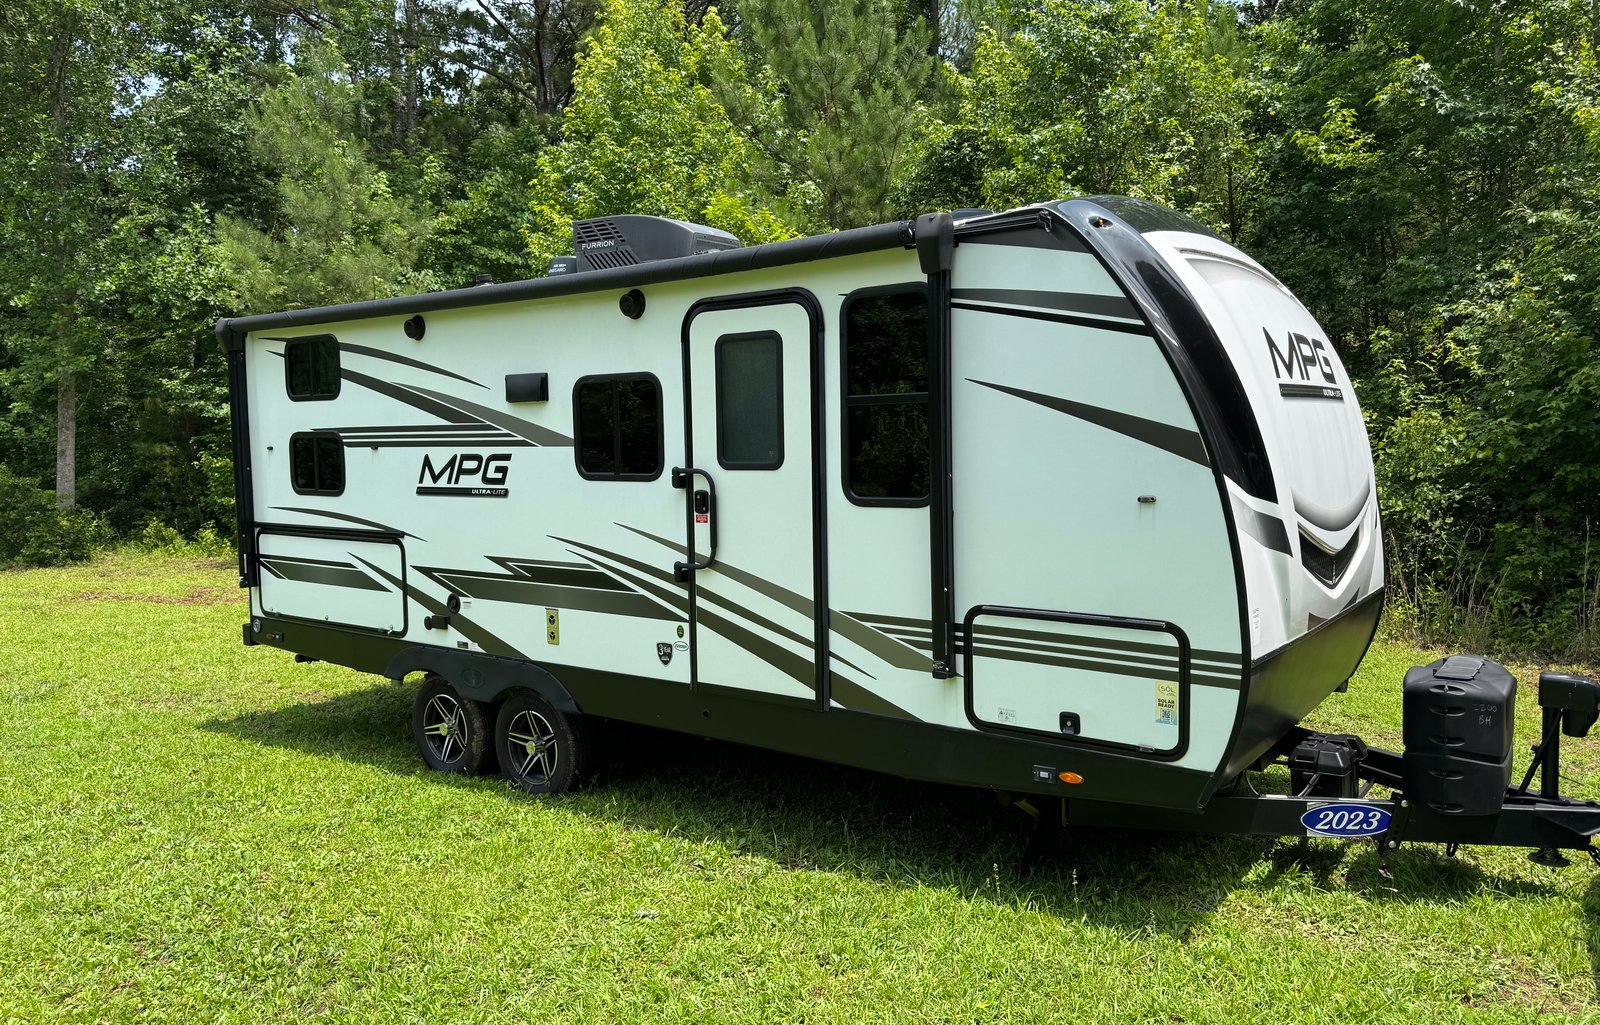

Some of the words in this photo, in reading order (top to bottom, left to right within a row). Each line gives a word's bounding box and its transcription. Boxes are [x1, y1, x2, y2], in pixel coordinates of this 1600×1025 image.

[581, 239, 615, 250] FURRION
[1262, 326, 1337, 385] MPG
[418, 453, 512, 485] MPG
[471, 488, 506, 496] ULTRA-LITE
[658, 643, 664, 656] 3
[1478, 714, 1492, 727] BH
[1315, 811, 1381, 830] 2023
